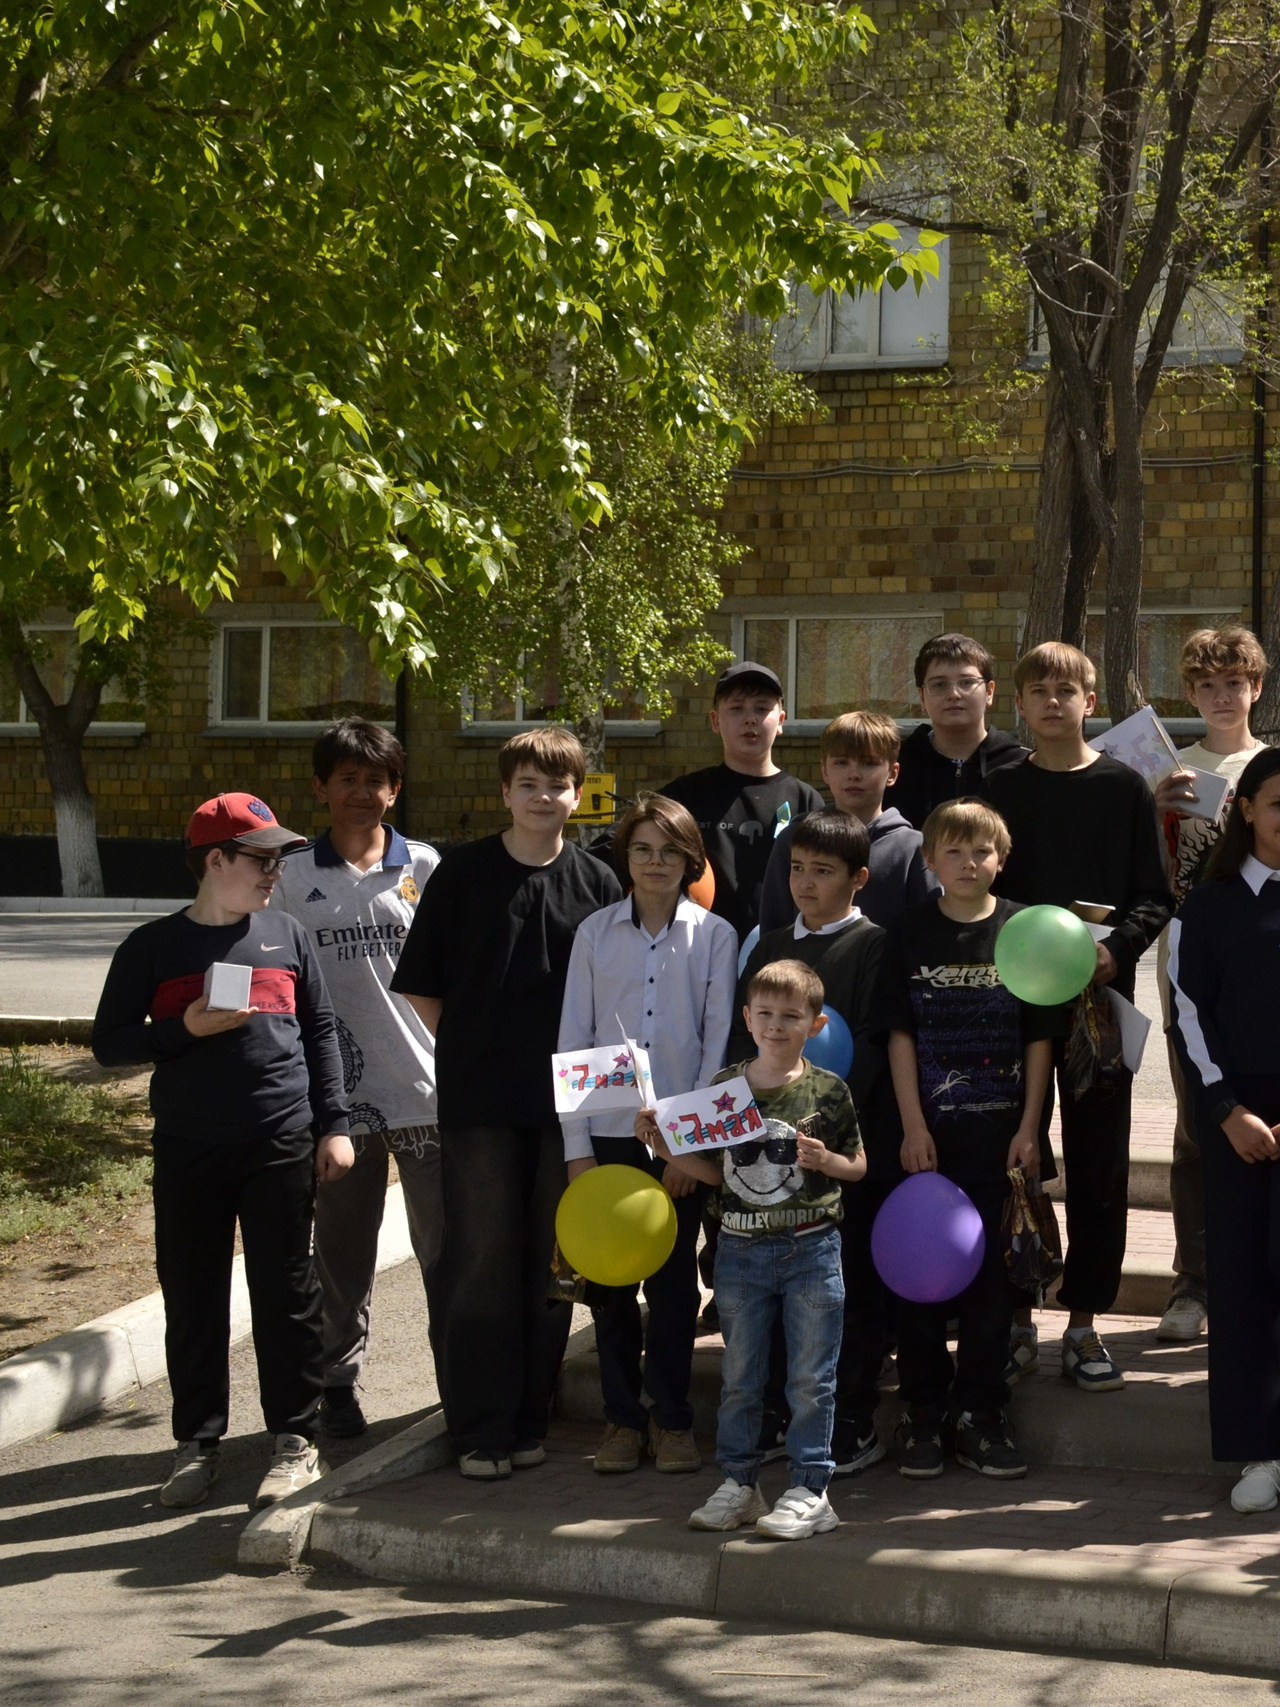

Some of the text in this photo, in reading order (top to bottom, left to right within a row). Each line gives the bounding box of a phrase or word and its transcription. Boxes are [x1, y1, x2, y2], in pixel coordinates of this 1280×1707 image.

[315, 922, 409, 947] Emirate
[338, 942, 401, 961] FLY BETTER
[572, 1064, 588, 1091] 7
[678, 1113, 706, 1144] 7
